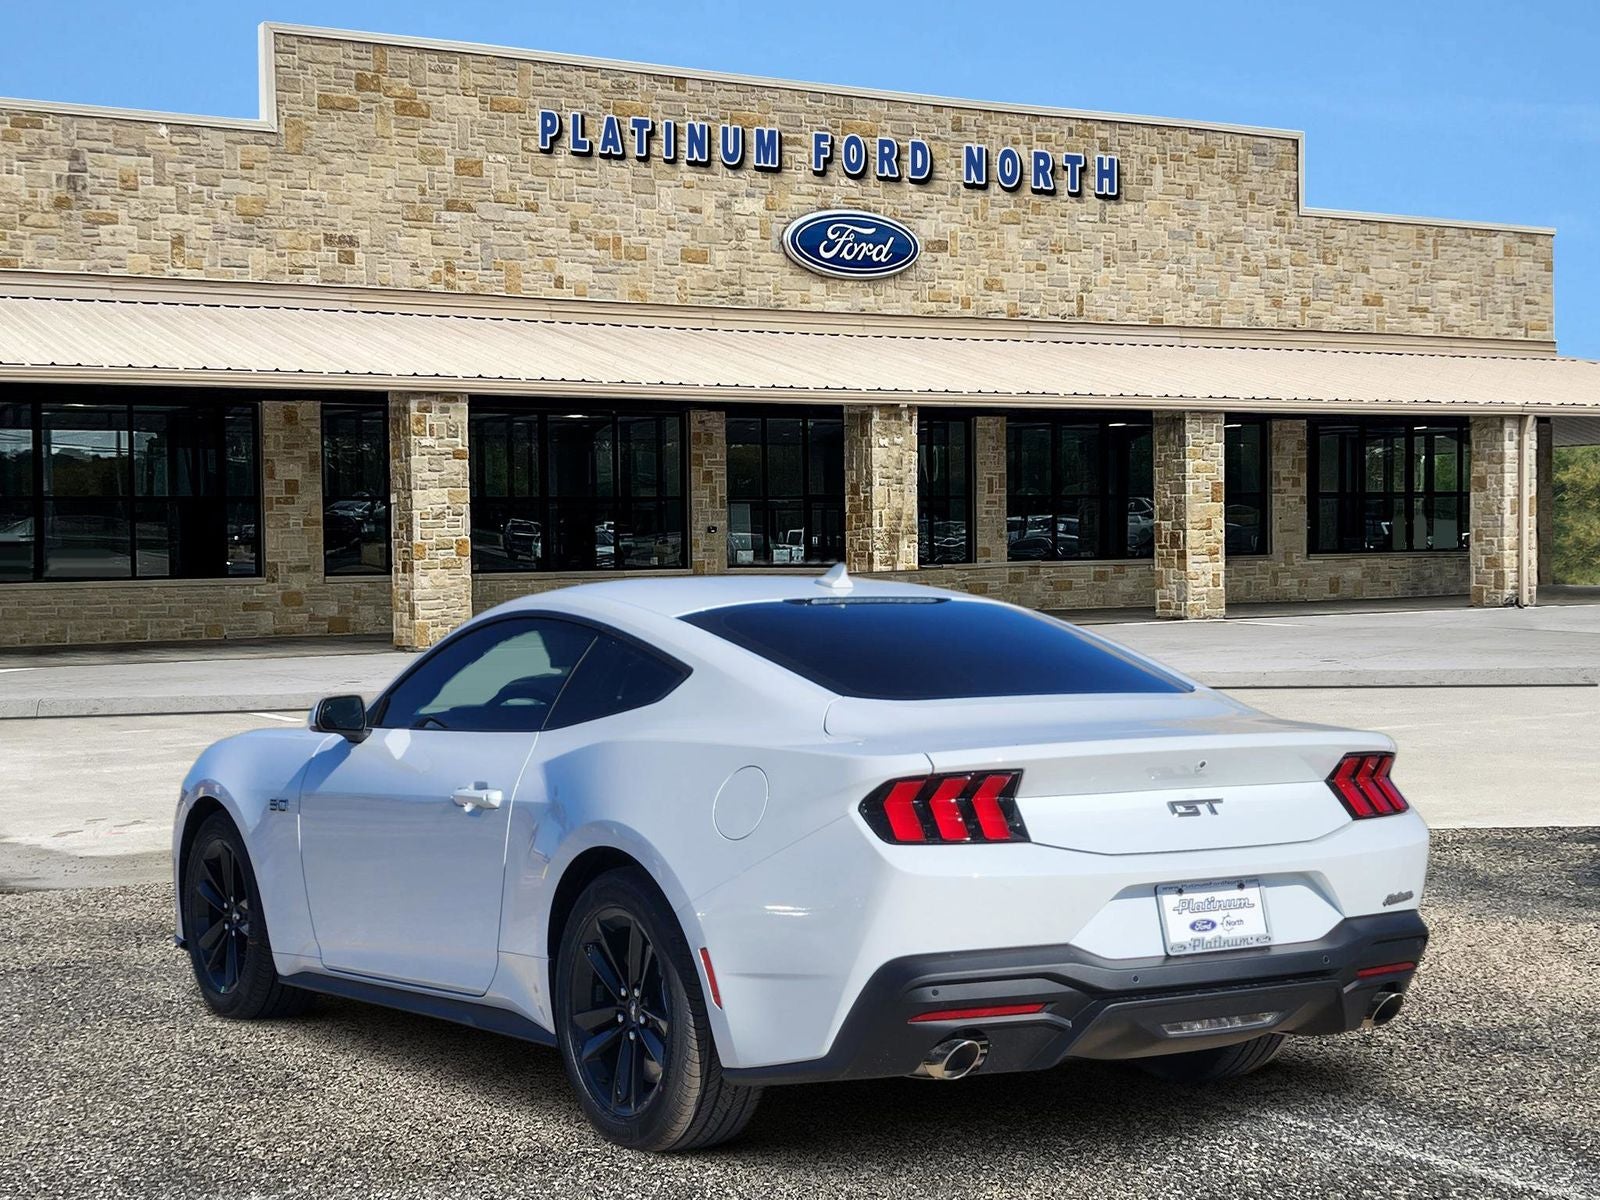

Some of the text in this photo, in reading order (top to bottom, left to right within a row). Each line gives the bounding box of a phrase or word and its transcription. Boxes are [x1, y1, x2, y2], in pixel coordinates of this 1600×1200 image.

[538, 109, 1121, 200] PLATINUM FORD NORTH
[818, 222, 893, 264] Ford
[1167, 797, 1224, 818] GT
[1173, 896, 1255, 915] Platinum
[1225, 917, 1245, 927] North
